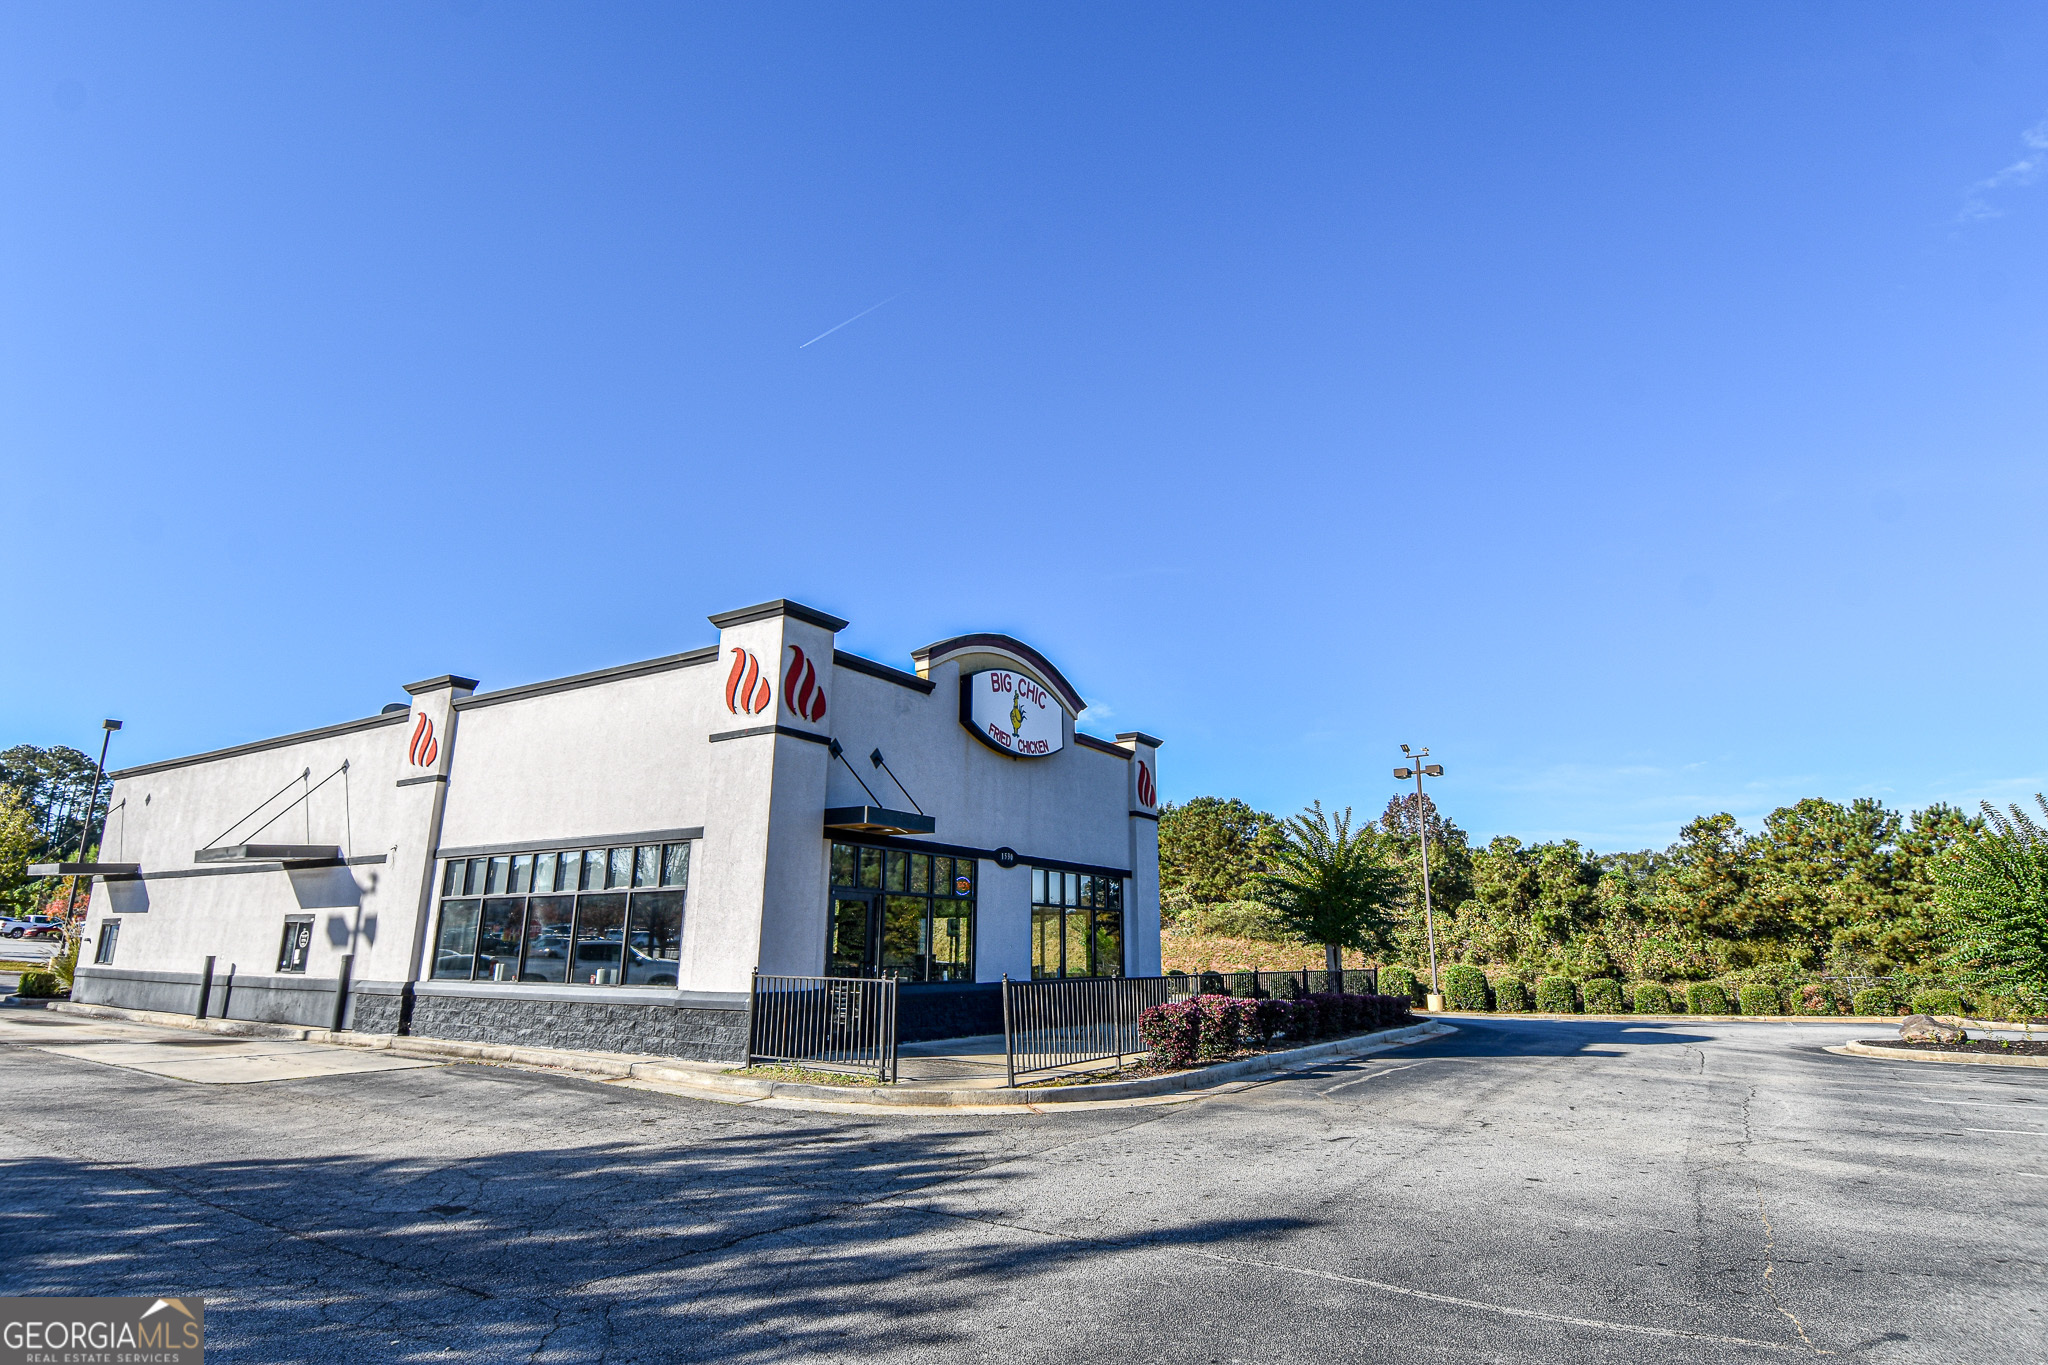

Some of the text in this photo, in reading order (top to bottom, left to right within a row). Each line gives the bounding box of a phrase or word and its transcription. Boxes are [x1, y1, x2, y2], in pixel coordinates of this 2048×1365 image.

[991, 672, 1047, 709] BIG CHIC
[988, 722, 1049, 754] FRIED CHICKEN
